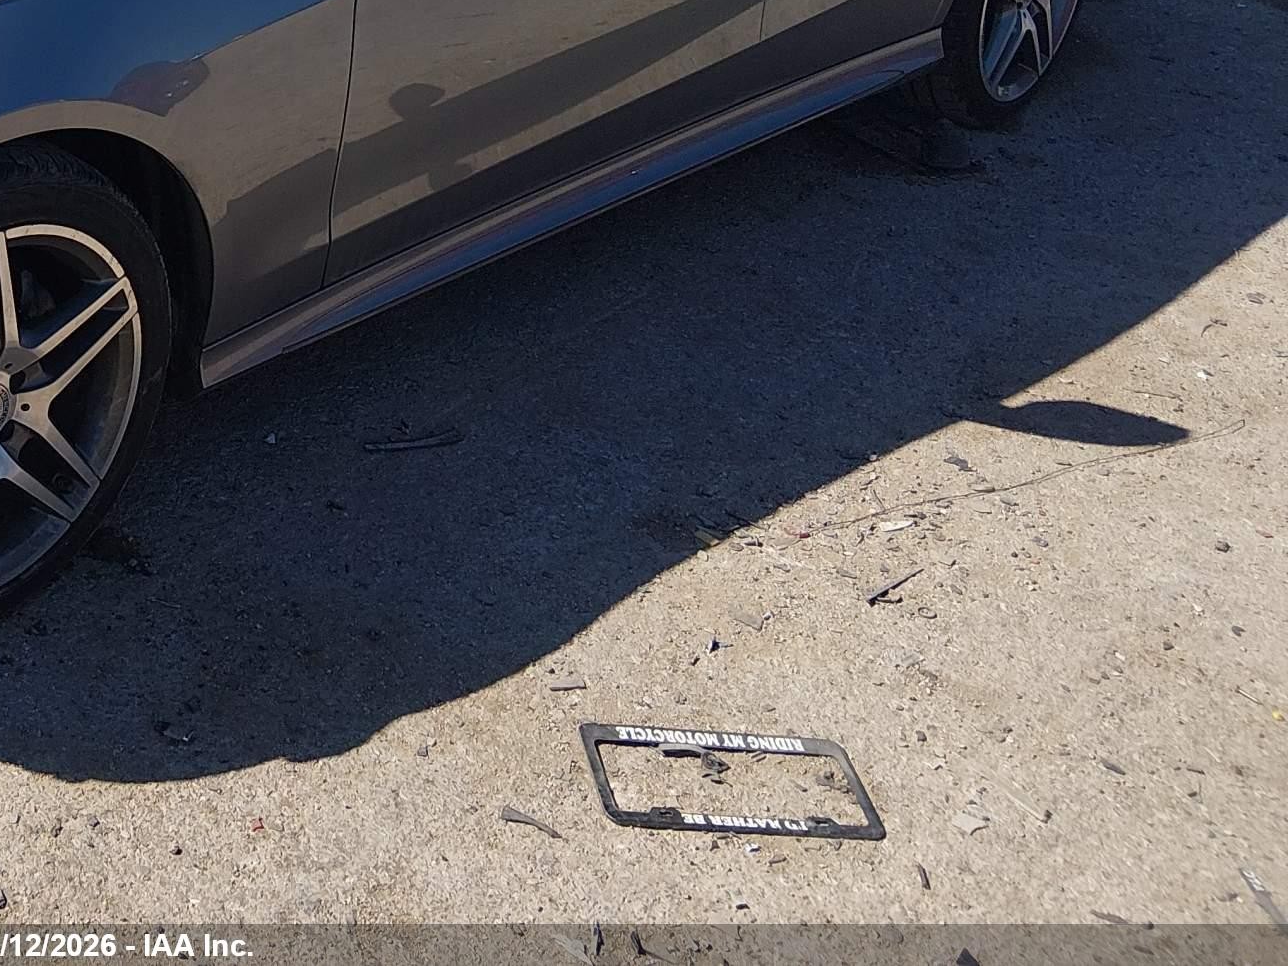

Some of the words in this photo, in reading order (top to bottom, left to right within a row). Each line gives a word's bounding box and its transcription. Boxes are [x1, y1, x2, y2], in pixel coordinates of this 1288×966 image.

[615, 726, 718, 746] MOTORCYCLE
[721, 733, 746, 748] MY
[747, 735, 805, 752] RIDING
[681, 813, 707, 825] BE
[708, 815, 782, 829] RATHER
